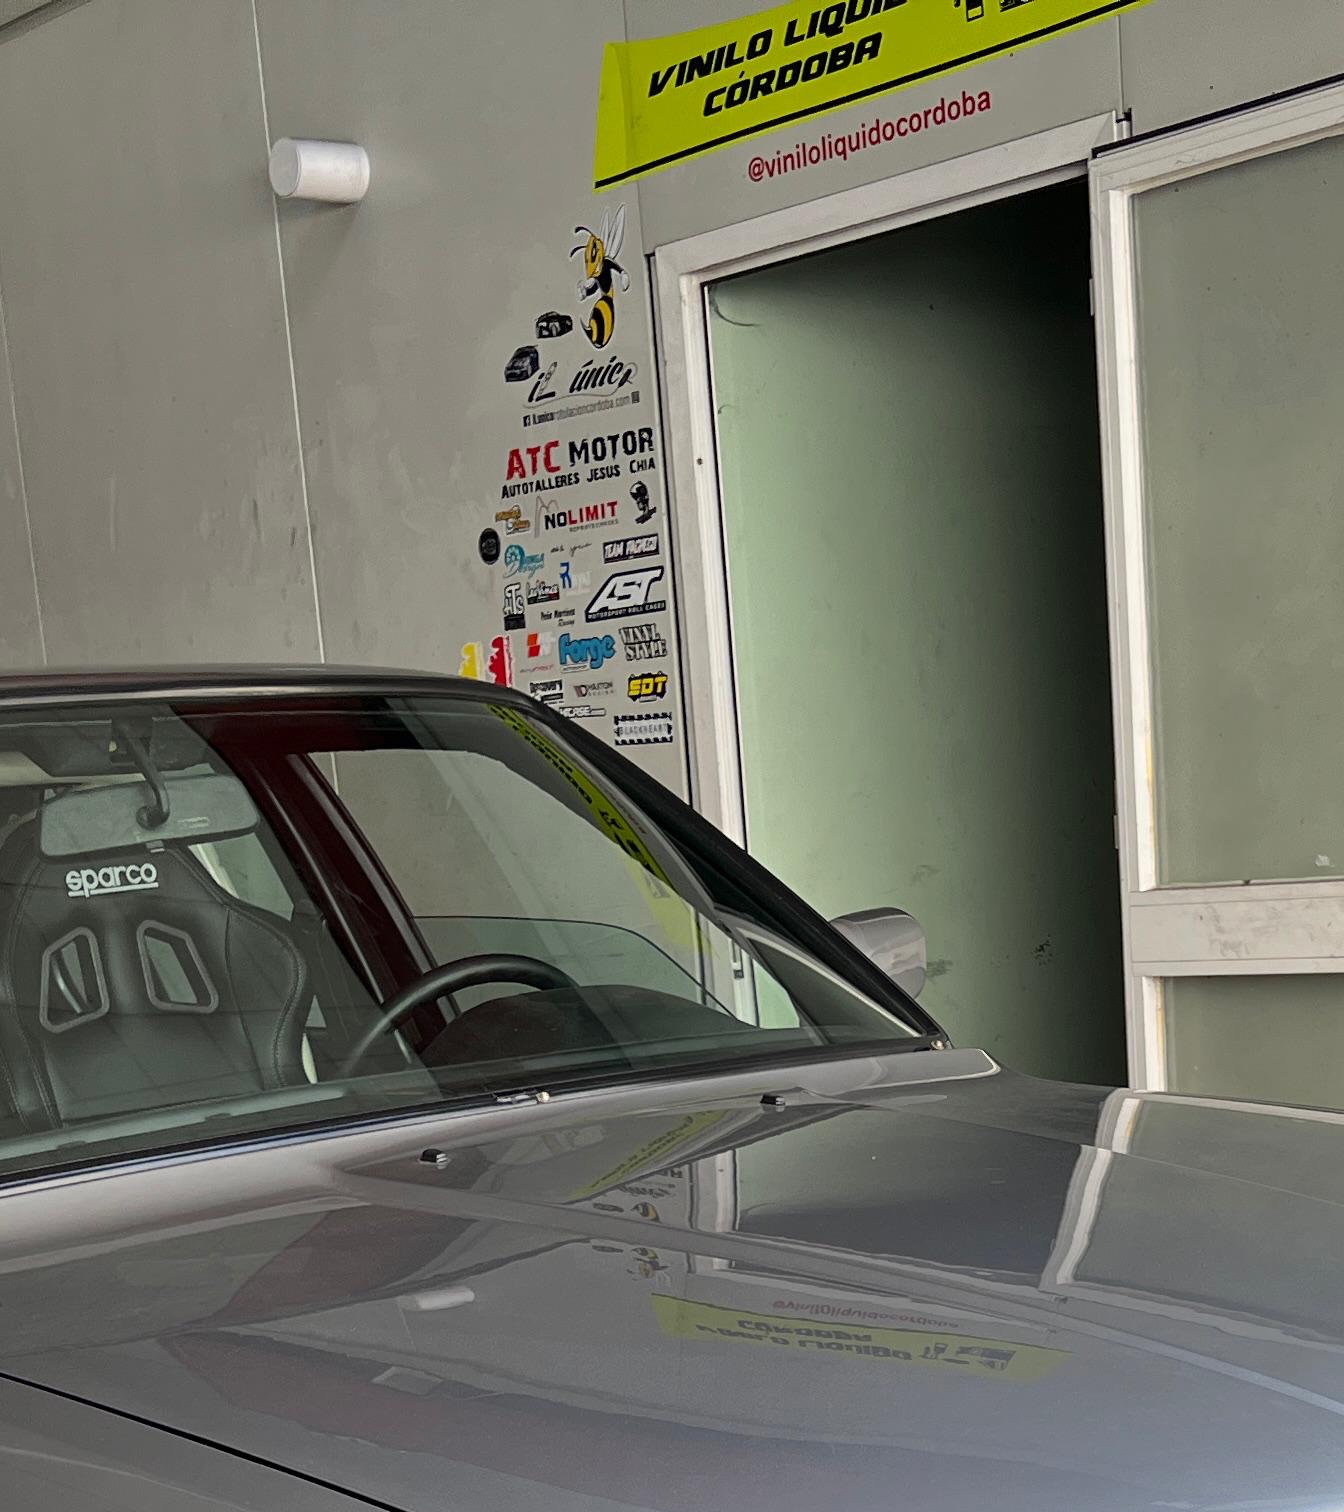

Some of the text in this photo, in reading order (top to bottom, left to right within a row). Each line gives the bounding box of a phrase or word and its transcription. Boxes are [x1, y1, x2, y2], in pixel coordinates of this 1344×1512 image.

[648, 28, 773, 98] VINILO
[703, 32, 883, 117] CÓRDOBA
[748, 90, 991, 182] @viniloliquidocordoba
[506, 427, 655, 480] ATC MOTOR
[587, 464, 620, 482] JESUS
[65, 862, 157, 898] sparco
